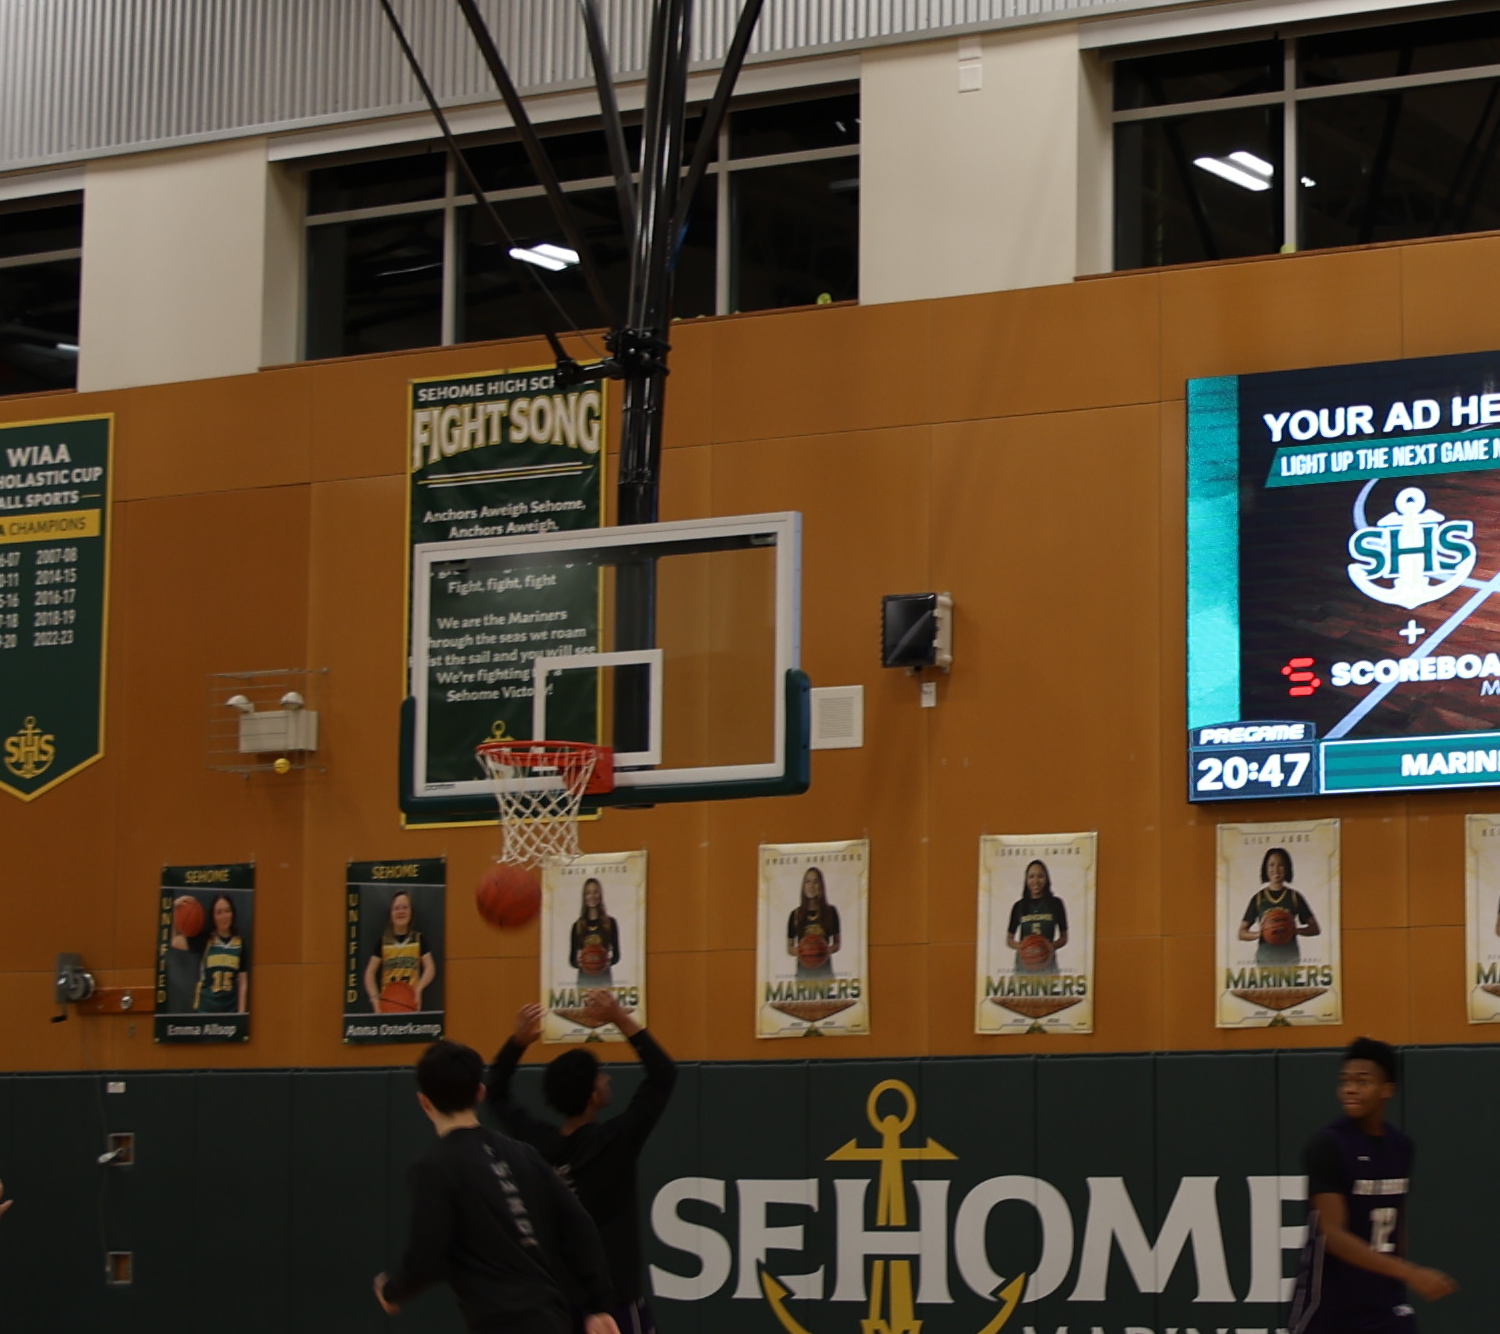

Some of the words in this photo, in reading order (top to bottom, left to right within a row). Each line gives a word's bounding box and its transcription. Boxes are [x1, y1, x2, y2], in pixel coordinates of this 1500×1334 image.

[417, 382, 485, 402] SEHOME
[487, 378, 528, 396] HIGH
[1263, 405, 1374, 443] YOUR
[1385, 398, 1441, 433] AD
[412, 399, 509, 474] FIGHT
[509, 390, 601, 454] SONG
[6, 443, 72, 468] WIAA
[1280, 450, 1329, 478] LIGHT
[1330, 449, 1354, 473] UP
[1357, 446, 1389, 470] THE
[1393, 442, 1437, 467] NEXT
[1441, 437, 1489, 463] GAME
[71, 466, 103, 484] CUP
[25, 490, 80, 509] SPORTS
[423, 509, 478, 523] Anchors
[480, 502, 528, 519] Aweigh
[531, 498, 586, 513] Sehome,
[8, 516, 86, 536] CHAMPIONS
[449, 523, 504, 539] Anchors
[1352, 521, 1472, 578] SHS
[35, 568, 77, 586] 2014-15
[524, 573, 557, 589] fight
[34, 589, 76, 607] 2016-17
[437, 617, 460, 629] We
[461, 618, 481, 628] are
[483, 613, 506, 626] the
[507, 610, 568, 625] Mariners
[33, 630, 75, 647] 2022-23
[475, 632, 497, 645] the
[499, 632, 528, 643] seas
[530, 631, 549, 640] we
[550, 627, 587, 639] roam
[444, 653, 466, 666] the
[468, 650, 491, 663] sail
[492, 649, 518, 662] and
[436, 671, 475, 684] We're
[477, 668, 530, 684] fighting
[446, 689, 500, 702] Sehome
[1199, 723, 1305, 746] PREGAME
[3, 733, 56, 764] SHS
[1197, 752, 1311, 792] 20:47
[185, 869, 230, 884] SEHOME
[371, 864, 419, 880] SEHOME
[156, 896, 172, 1004] UNIFIED
[347, 893, 360, 1003] UNIFIED
[985, 974, 1087, 997] MARINERS
[1226, 964, 1333, 989] MARINERS
[765, 978, 861, 1002] MARINERS
[167, 1024, 202, 1037] Emma
[347, 1024, 378, 1037] Anna
[379, 1022, 442, 1037] Osterkamp
[649, 1174, 1310, 1305] SEHOME
